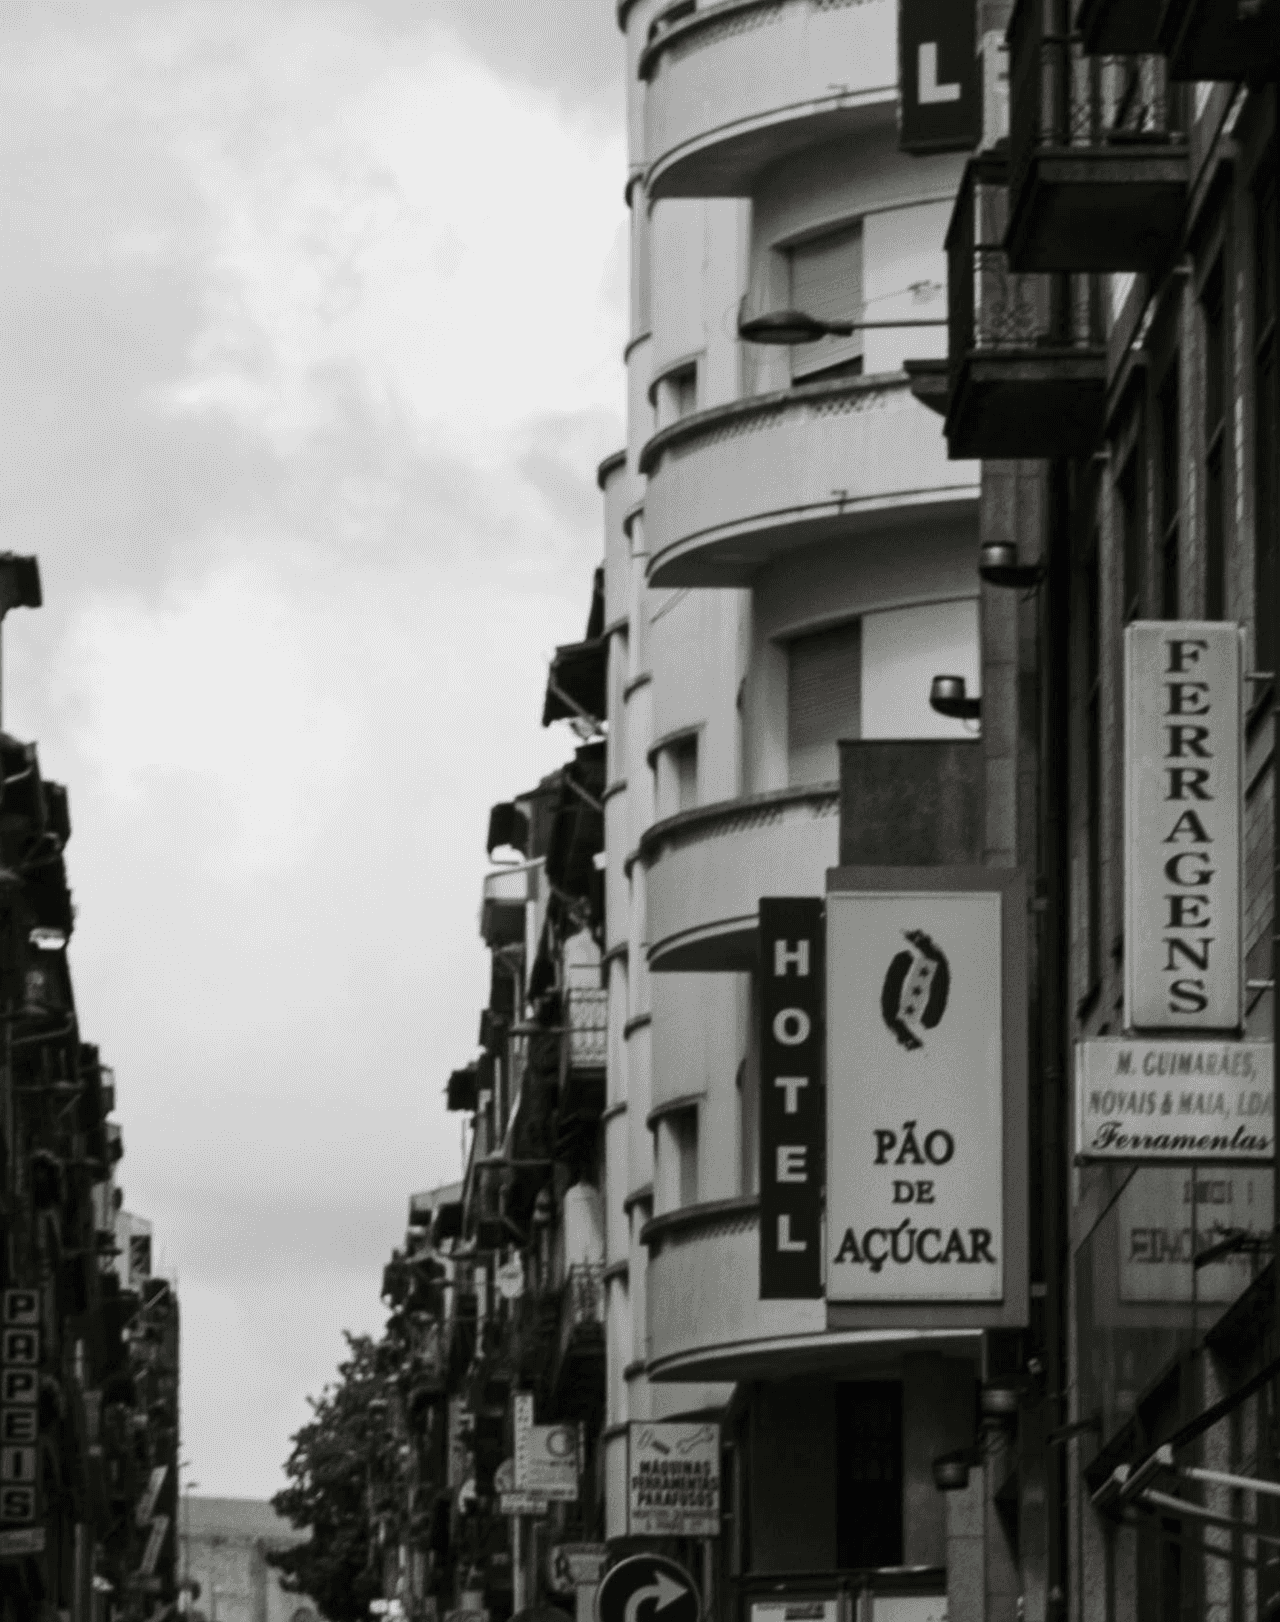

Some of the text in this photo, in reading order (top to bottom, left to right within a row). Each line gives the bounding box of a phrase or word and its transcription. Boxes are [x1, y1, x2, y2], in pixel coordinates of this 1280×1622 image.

[1163, 639, 1216, 1015] FERRAGENS
[772, 939, 812, 1252] HOTEL
[873, 1121, 955, 1165] PÃO
[1091, 1121, 1274, 1150] Ferramentas
[892, 1180, 936, 1204] DE
[833, 1218, 997, 1273] AÇÚCAR
[5, 1294, 38, 1517] PAPEIS
